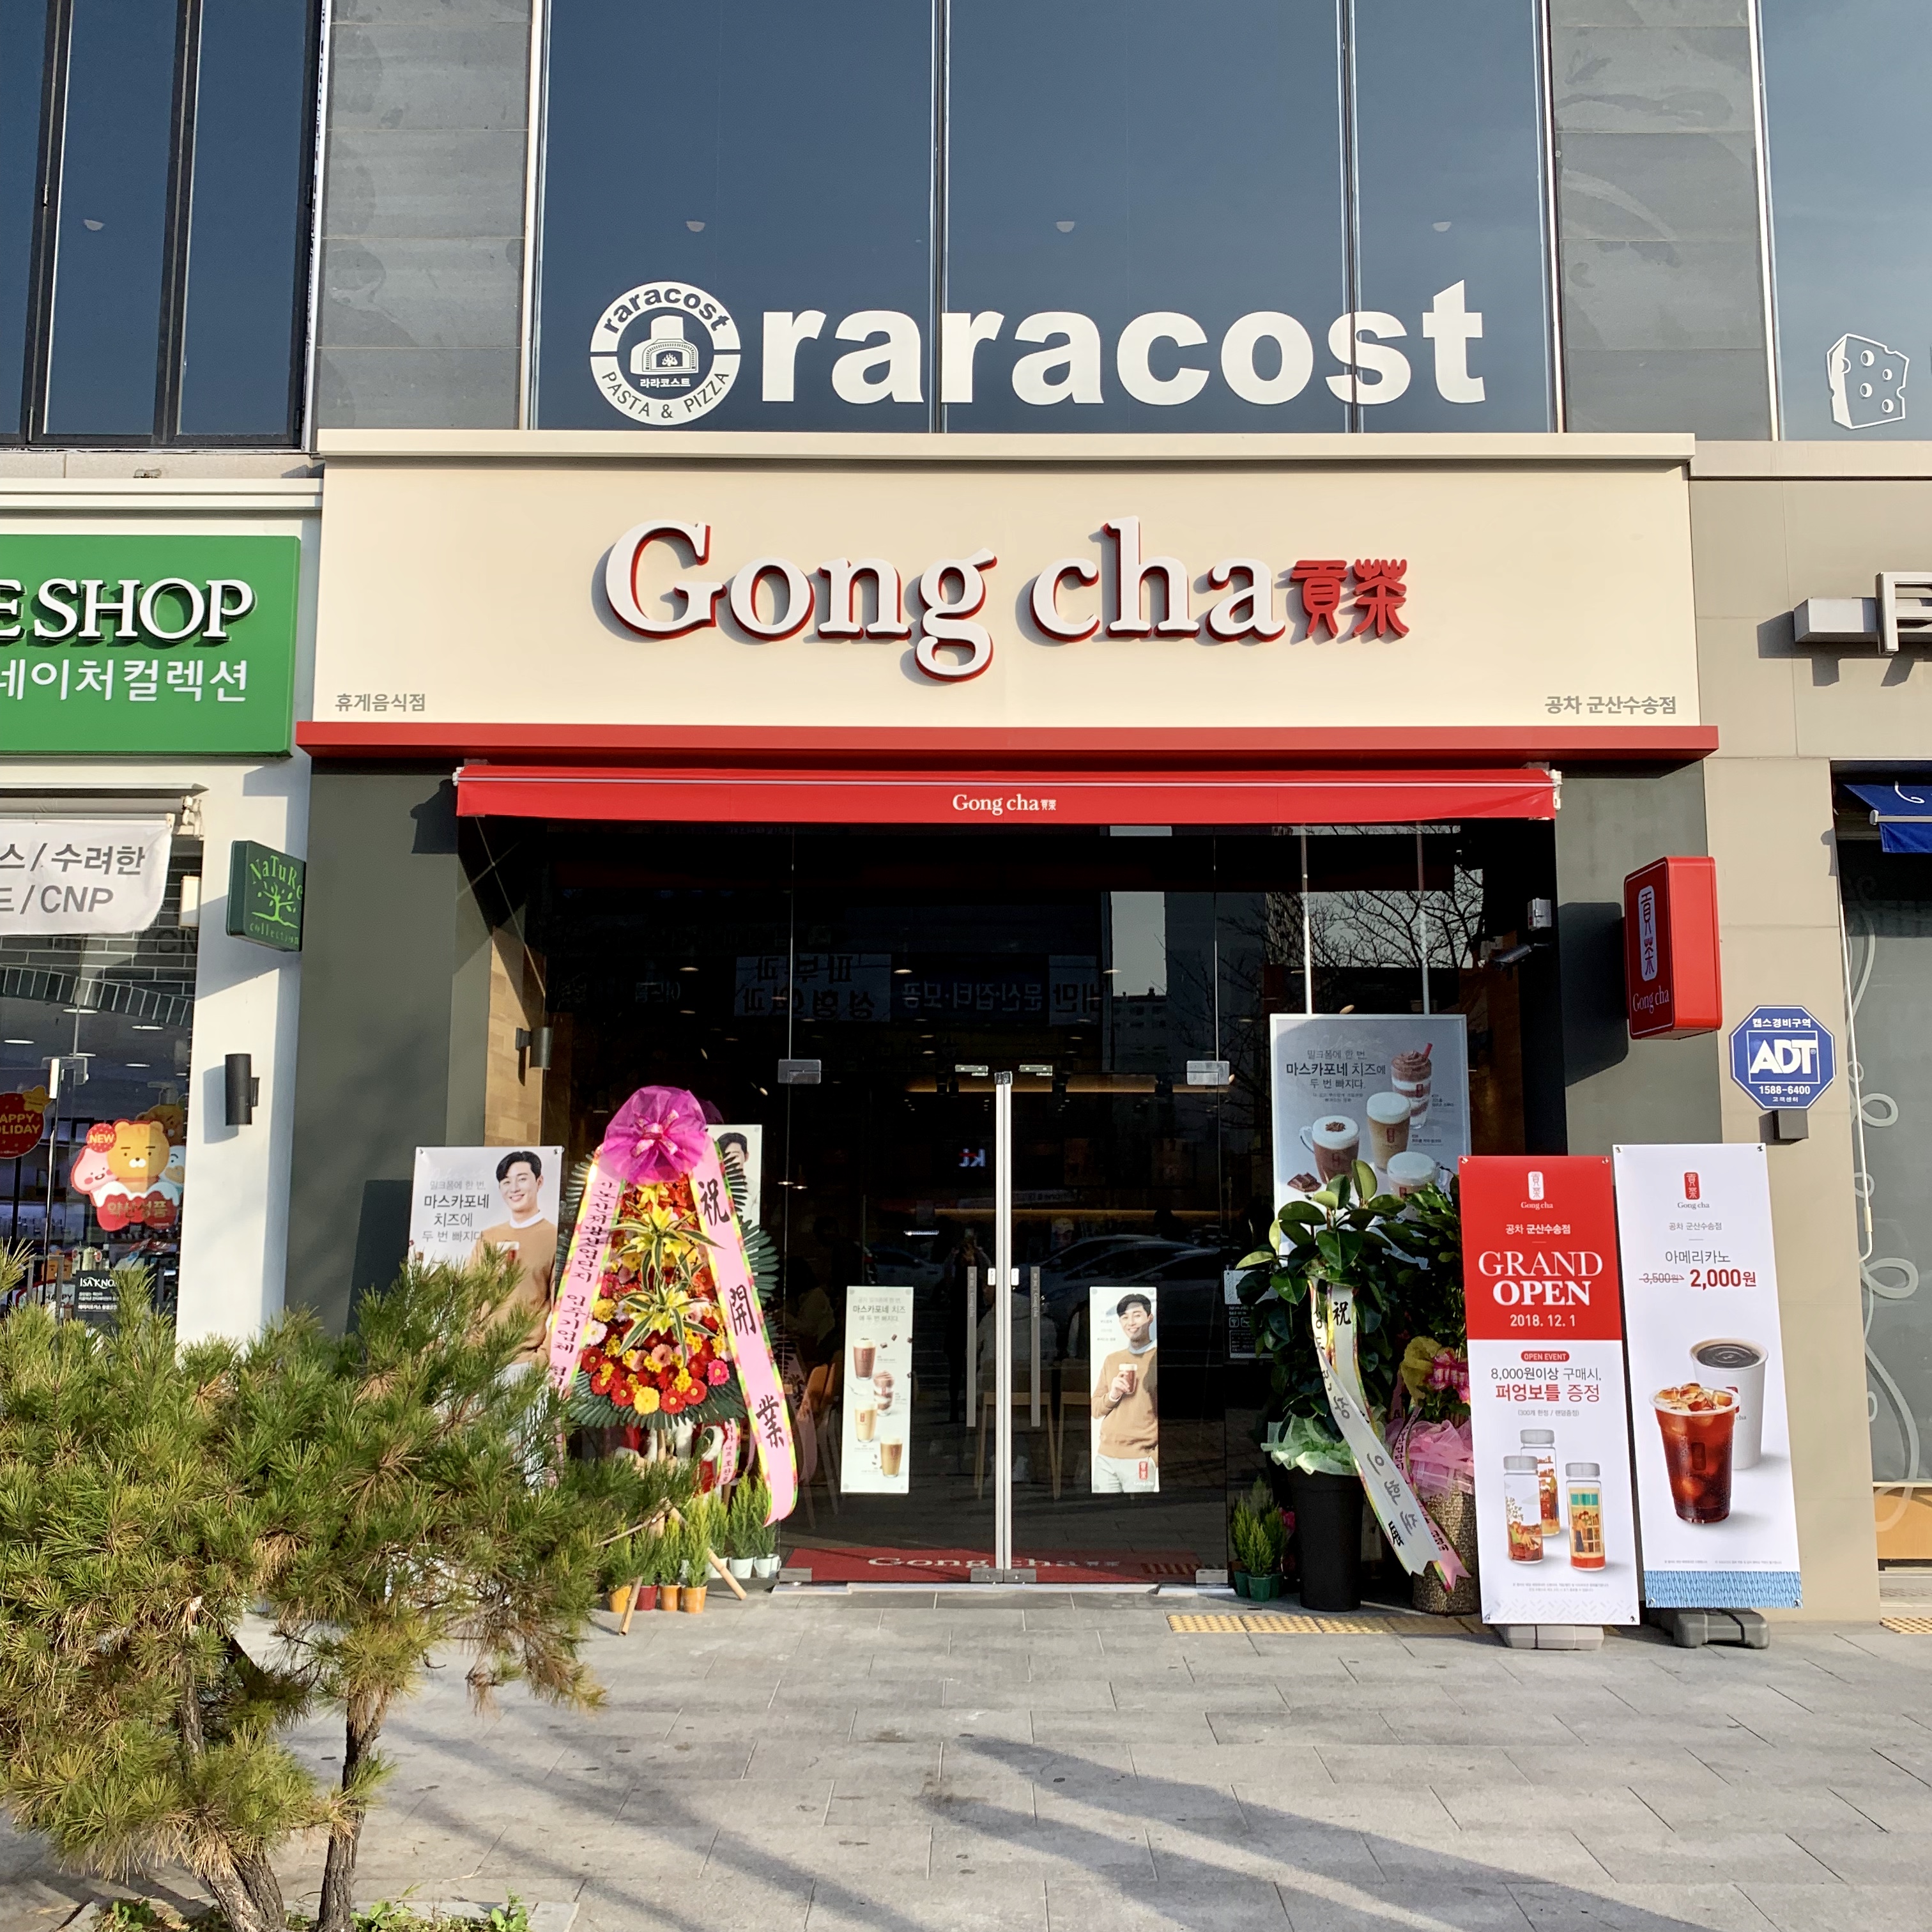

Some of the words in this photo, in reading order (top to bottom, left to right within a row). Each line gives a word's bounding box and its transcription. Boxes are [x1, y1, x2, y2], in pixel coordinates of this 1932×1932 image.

[603, 287, 730, 335] raracost
[762, 279, 1485, 406] raracost
[640, 377, 691, 388] 라라코스트
[601, 370, 651, 418] PASTA
[661, 404, 674, 419] &
[685, 370, 730, 414] PIZZA
[604, 519, 998, 684] Gong
[1029, 514, 1287, 643] cha
[334, 693, 425, 712] 휴게음식점
[1544, 695, 1583, 715] 공차
[1586, 695, 1676, 715] 군산수송점
[952, 793, 1004, 816] Gong
[1006, 793, 1040, 811] cha
[1632, 992, 1654, 1015] Gong
[1654, 985, 1670, 1007] cha
[1752, 1018, 1811, 1028] 캡스경비구역
[1750, 1039, 1818, 1074] ADT
[1286, 1062, 1348, 1077] 마스카포네
[1351, 1062, 1386, 1077] 치즈에
[1310, 1078, 1319, 1089] 두
[1322, 1078, 1333, 1089] 번
[1759, 1085, 1811, 1094] 1588-6400
[89, 1133, 115, 1144] NEW
[424, 1193, 489, 1209] 마스카포네
[1521, 1202, 1540, 1211] Gong
[1677, 1202, 1697, 1210] Gong
[434, 1212, 473, 1227] 치즈에
[1669, 1222, 1684, 1231] 공차
[1685, 1222, 1722, 1231] 군산수송점
[422, 1230, 434, 1243] 두
[438, 1230, 448, 1243] 번
[1505, 1223, 1524, 1235] 공차
[1526, 1223, 1572, 1235] 군산수송점
[1478, 1250, 1604, 1277] GRAND
[1665, 1250, 1731, 1264] 아메리카노
[1689, 1268, 1757, 1291] 2,000원
[1492, 1280, 1591, 1307] OPEN
[852, 1305, 889, 1314] 마스카포네
[892, 1305, 906, 1314] 치즈
[1332, 1301, 1352, 1326] 祝
[1510, 1314, 1544, 1328] 2018.
[1547, 1314, 1566, 1328] 12.
[1569, 1314, 1576, 1327] 1
[1491, 1367, 1560, 1381] 8,000원이상
[1495, 1383, 1561, 1402] 퍼엉보틀
[1567, 1383, 1600, 1402] 증정
[868, 1556, 991, 1568] Gong
